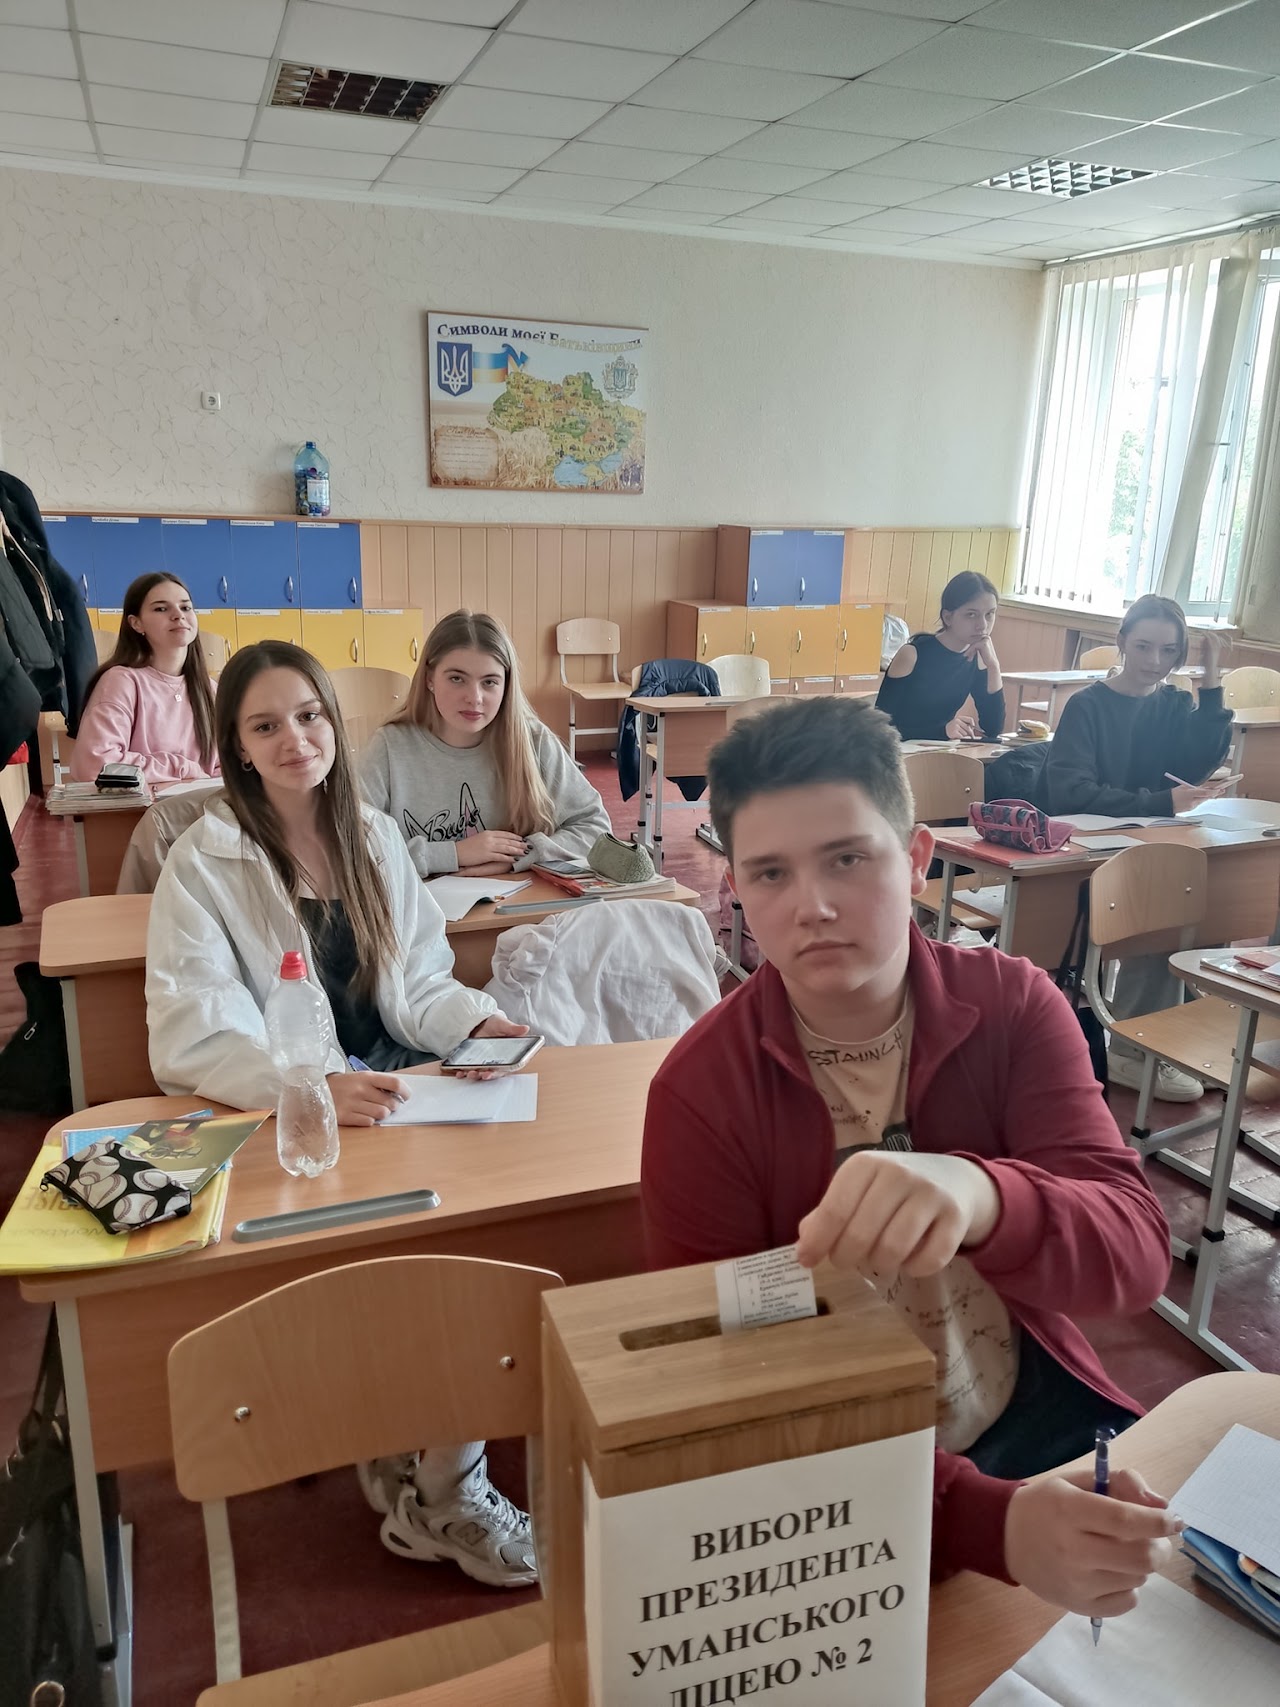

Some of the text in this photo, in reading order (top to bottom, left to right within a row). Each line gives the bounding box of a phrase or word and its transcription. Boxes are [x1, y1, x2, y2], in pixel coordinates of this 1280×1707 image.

[437, 324, 509, 338] Символи
[690, 1499, 853, 1562] ВИБОРИ
[639, 1538, 897, 1623] ПРЕЗИДЕНТА
[627, 1584, 905, 1678] УМАНСЬКОГО
[811, 1645, 847, 1678] №
[857, 1637, 874, 1665] 2
